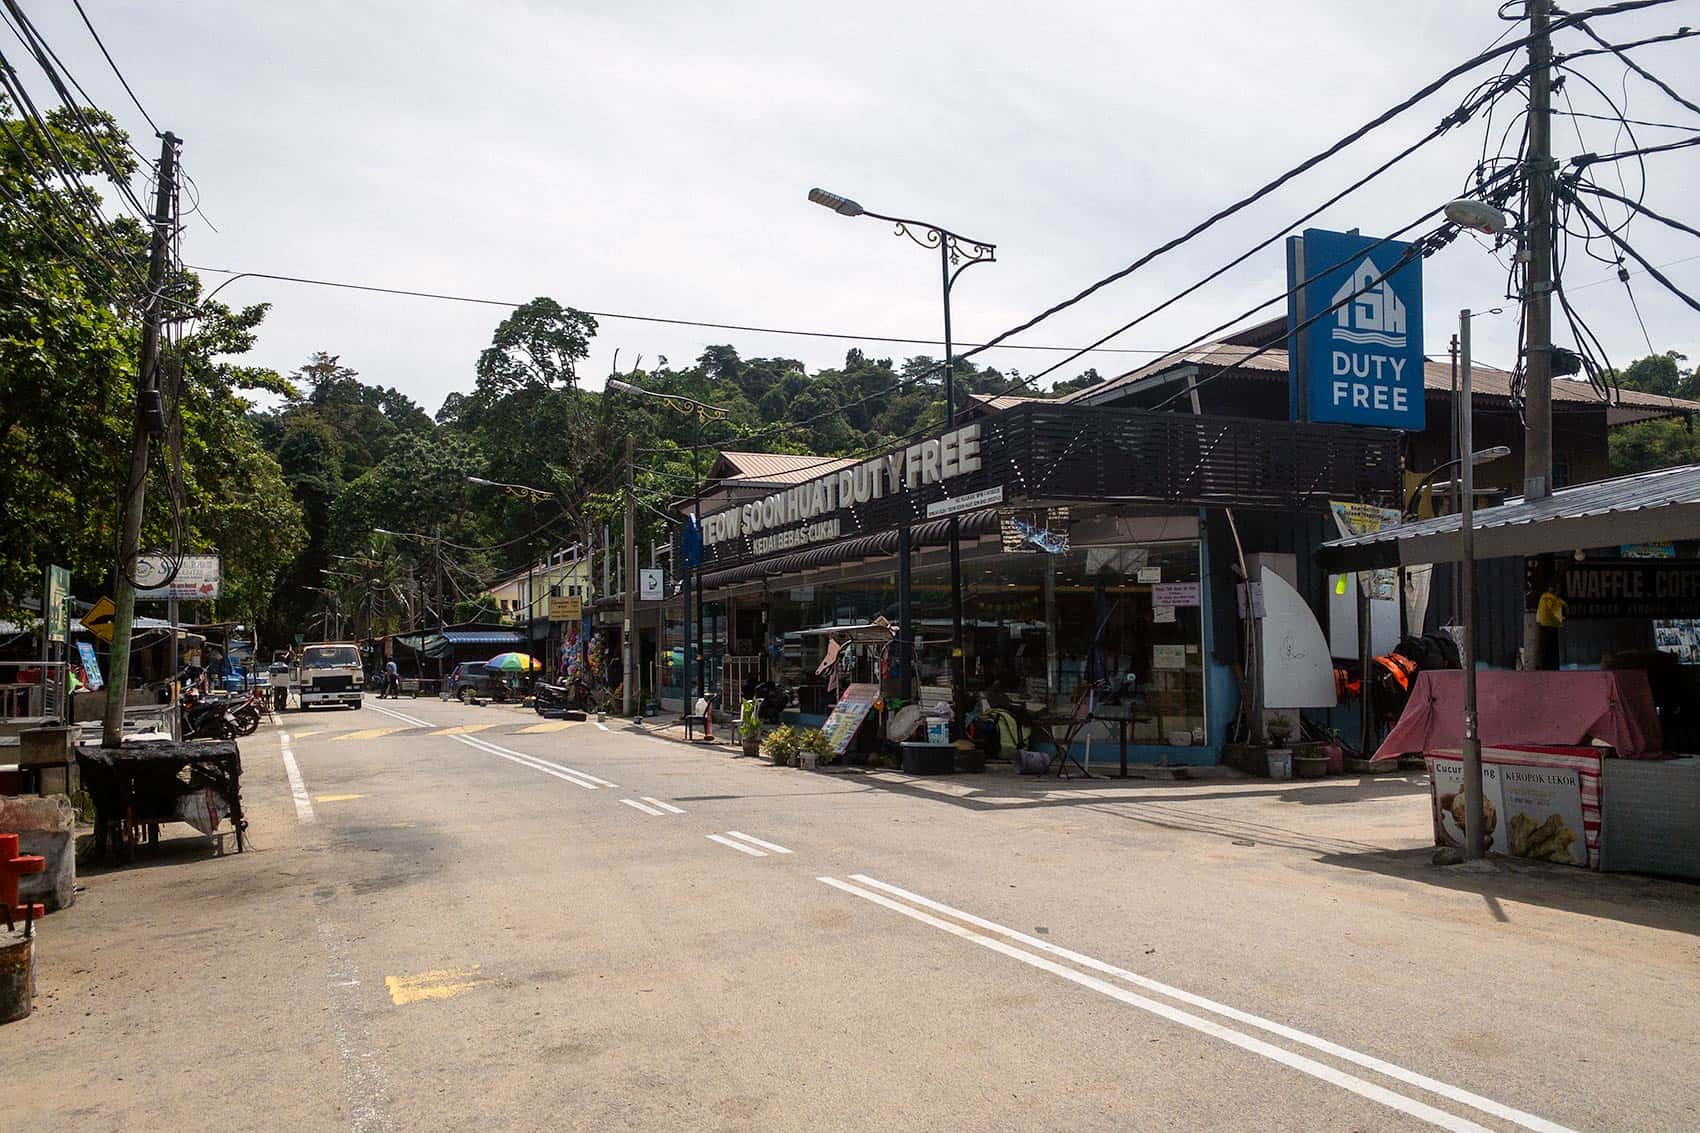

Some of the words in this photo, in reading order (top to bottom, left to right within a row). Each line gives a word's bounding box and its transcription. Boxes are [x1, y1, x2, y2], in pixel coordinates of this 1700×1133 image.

[1332, 351, 1407, 381] DUTY
[1333, 381, 1408, 411] FREE
[701, 506, 742, 545] TEOW
[742, 493, 784, 535] SOON
[787, 474, 838, 526] HUAT
[839, 451, 905, 508] DUTY
[906, 423, 981, 489] FREE
[753, 535, 777, 555] KEDAI
[1436, 764, 1462, 775] Cucur
[1506, 772, 1545, 784] KEROPOK
[1547, 775, 1577, 786] LEKOR
